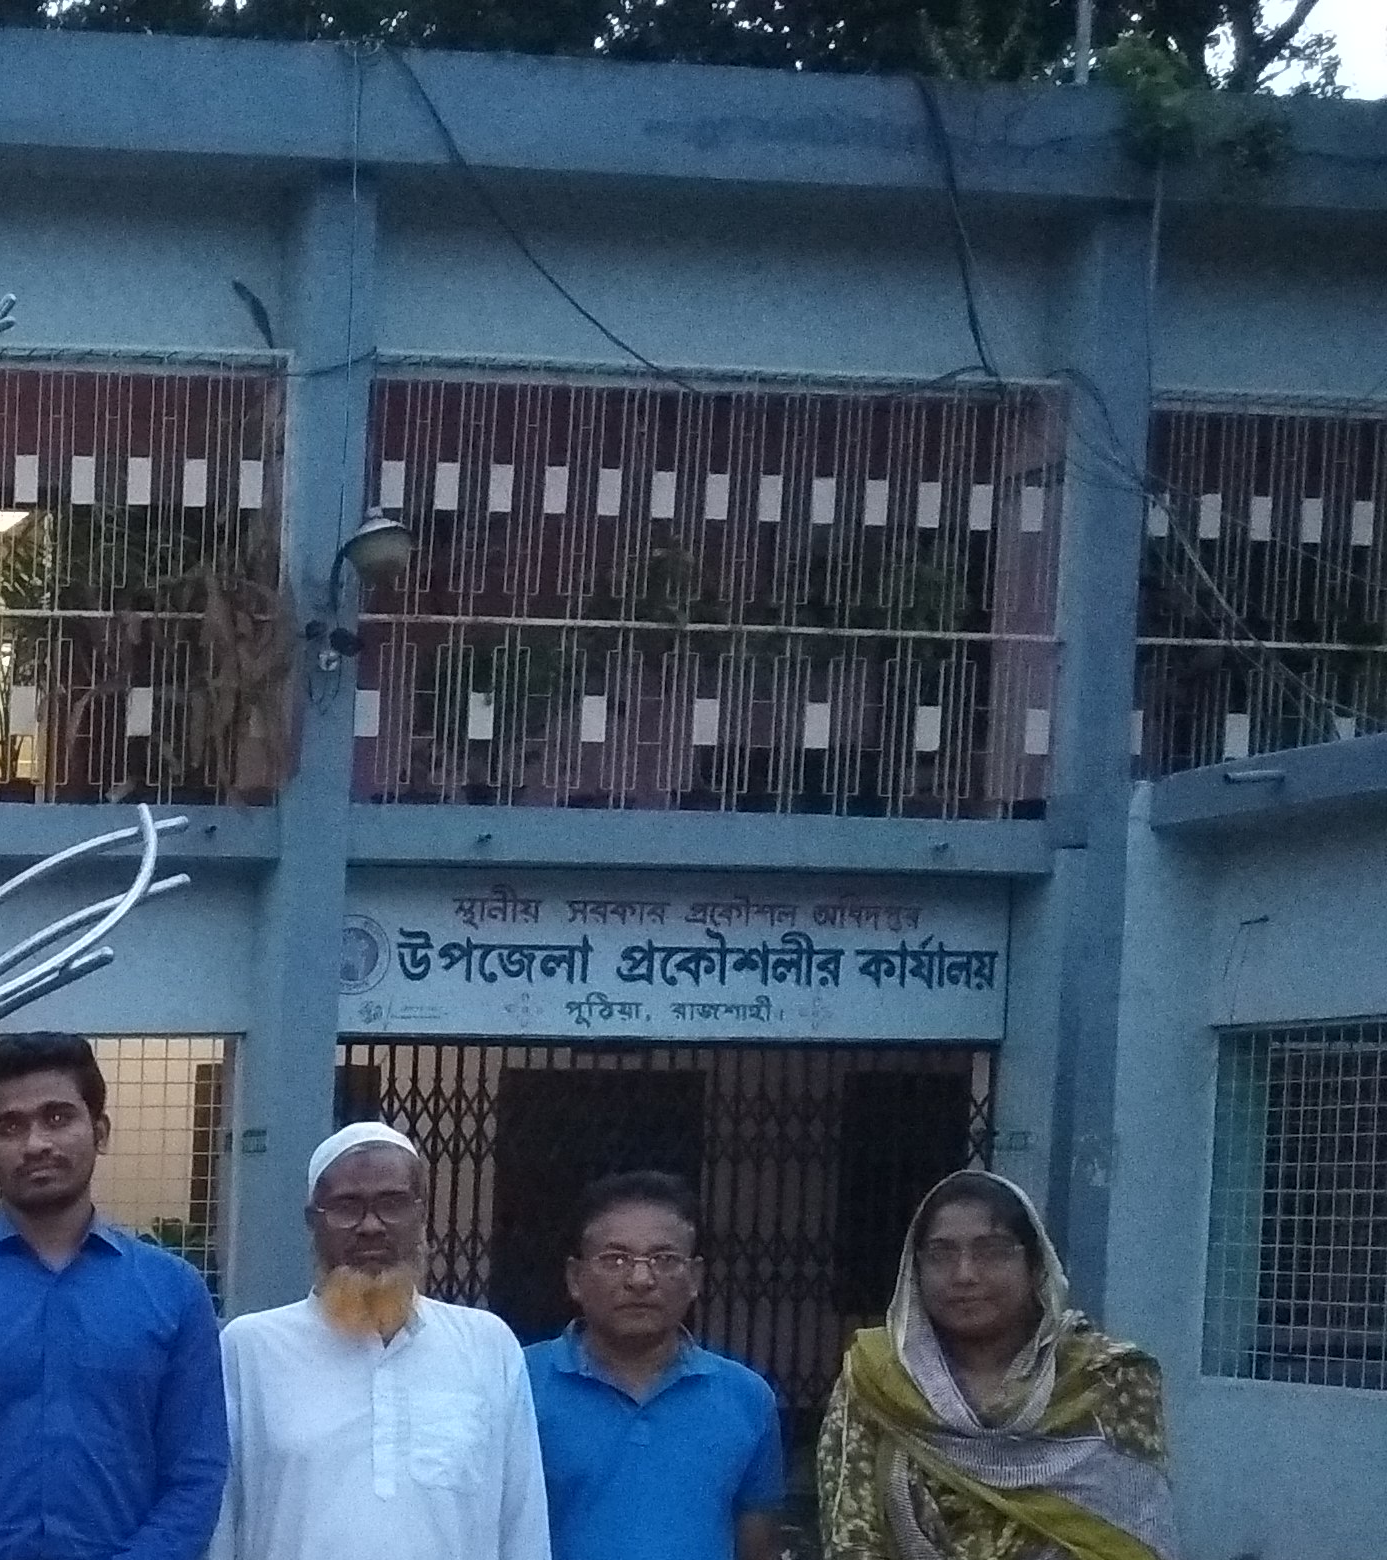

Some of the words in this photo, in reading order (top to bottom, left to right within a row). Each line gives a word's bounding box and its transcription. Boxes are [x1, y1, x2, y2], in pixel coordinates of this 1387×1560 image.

[452, 884, 542, 930] স্থানীয়
[566, 899, 671, 926] সরকার
[685, 896, 799, 929] প্রকৌশল
[396, 927, 594, 985] উপজেলা
[616, 928, 845, 988] প্রকৌশলীর
[856, 934, 998, 990] কার্যালয়
